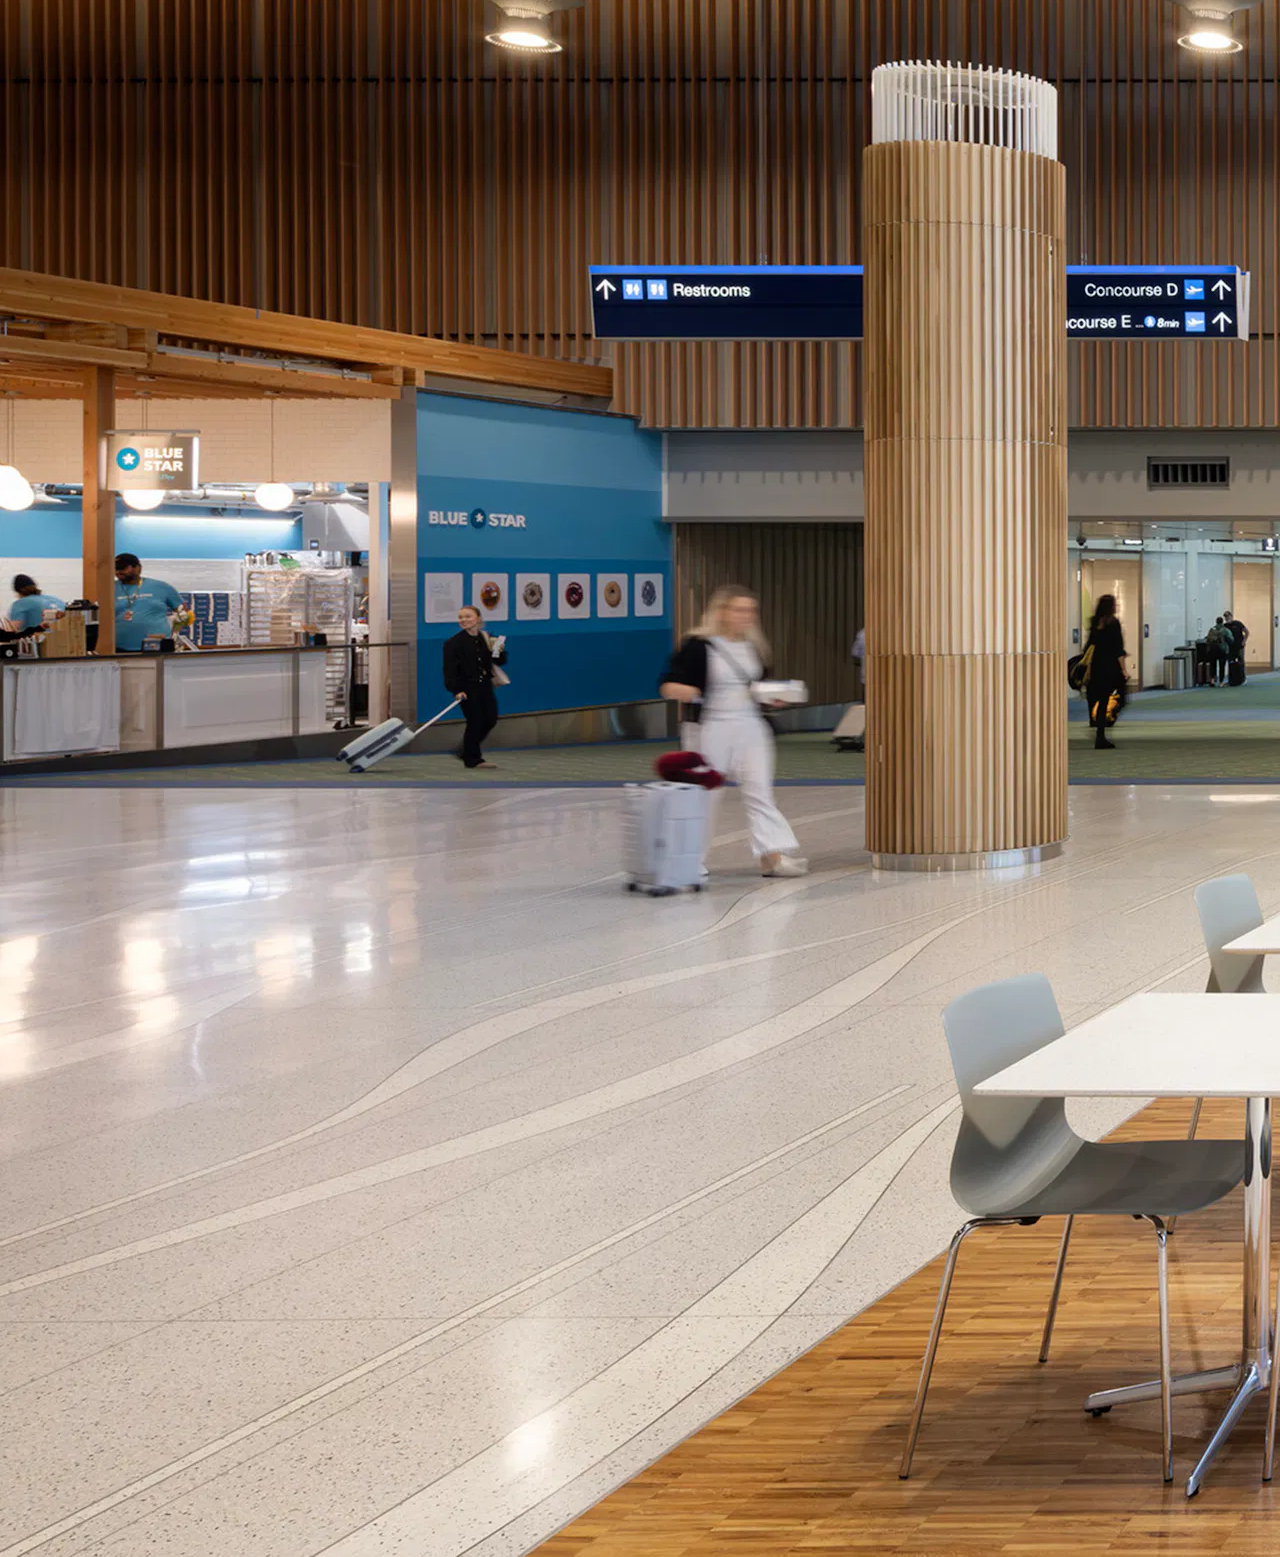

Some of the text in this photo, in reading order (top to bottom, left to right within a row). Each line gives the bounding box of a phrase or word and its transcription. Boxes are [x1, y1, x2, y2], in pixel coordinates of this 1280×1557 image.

[672, 282, 751, 298] Restrooms
[1084, 282, 1179, 297] Concourse D
[1066, 317, 1117, 330] course
[1121, 314, 1132, 329] E
[143, 447, 184, 459] BLUE
[143, 460, 184, 472] STAR
[428, 510, 526, 528] BLUE STAR
